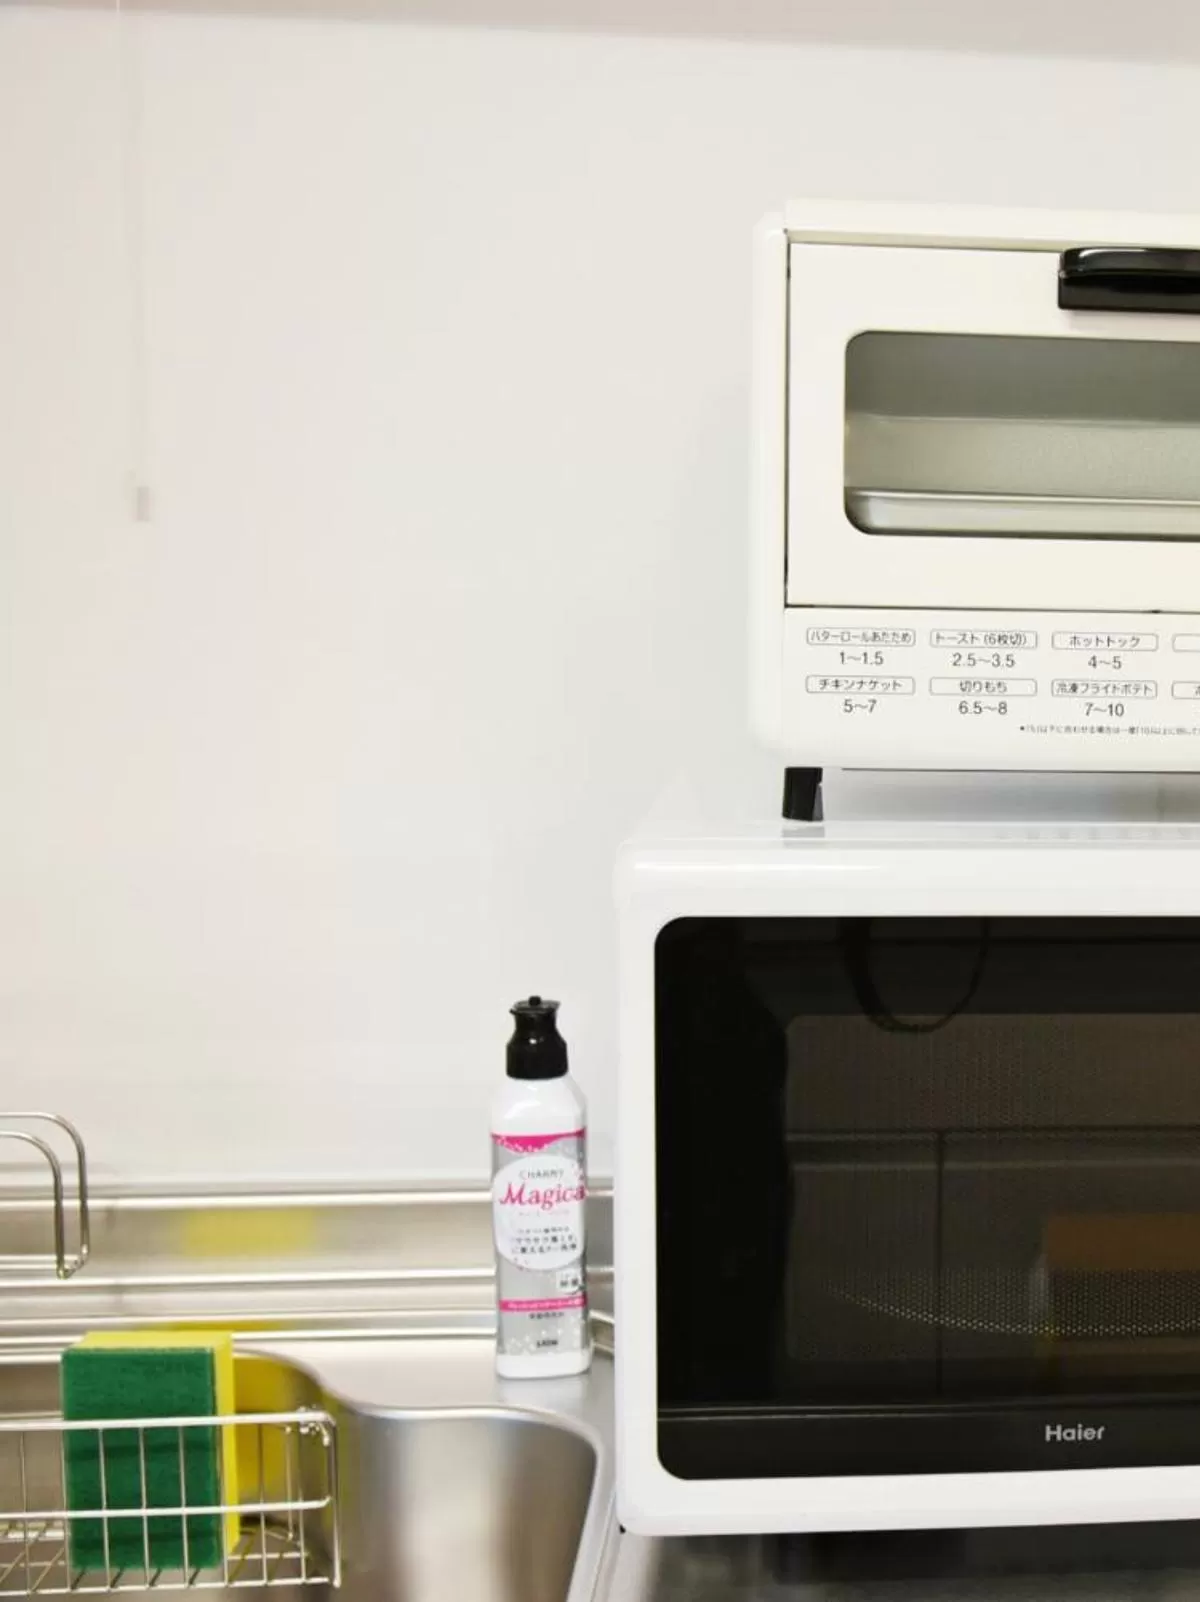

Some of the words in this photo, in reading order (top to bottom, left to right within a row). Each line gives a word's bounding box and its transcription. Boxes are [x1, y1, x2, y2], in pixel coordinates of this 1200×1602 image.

[959, 680, 1008, 693] 切りもち
[499, 1182, 586, 1210] Magica
[1045, 1423, 1105, 1442] Haier
